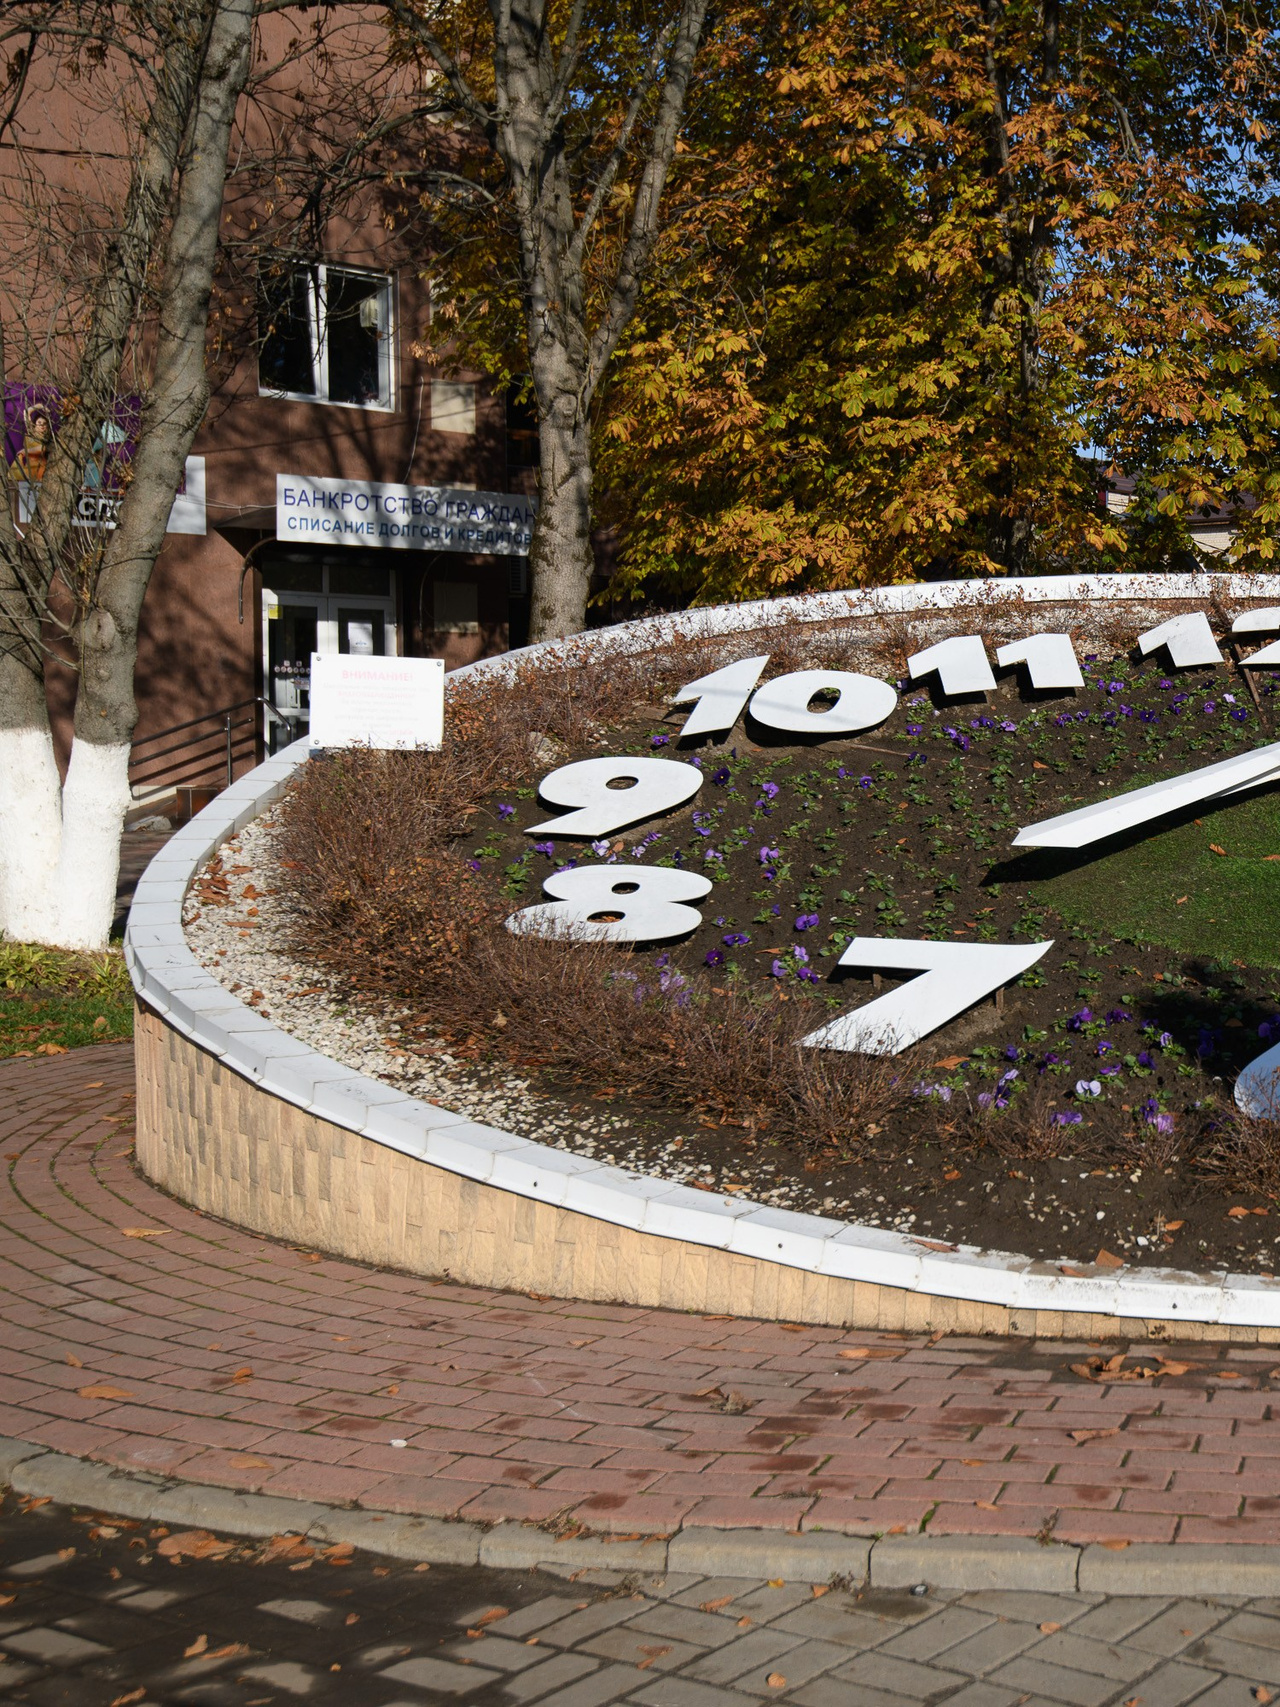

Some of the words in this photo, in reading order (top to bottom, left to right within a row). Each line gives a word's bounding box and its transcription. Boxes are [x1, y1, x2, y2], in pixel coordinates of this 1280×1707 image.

[284, 488, 438, 516] БАНКРОТСТВО
[446, 501, 536, 525] ГРАЖДАН
[287, 516, 375, 535] СПИСАНИЕ
[379, 522, 441, 539] ДОЛГОВ
[444, 527, 454, 540] И
[458, 528, 531, 545] КРЕДИТОВ
[341, 670, 414, 682] ВНИМАНИЕ!
[672, 655, 898, 736] 10
[907, 633, 1085, 695] 11
[524, 756, 703, 836] 9
[505, 864, 713, 942] 8
[796, 937, 1055, 1055] 7
